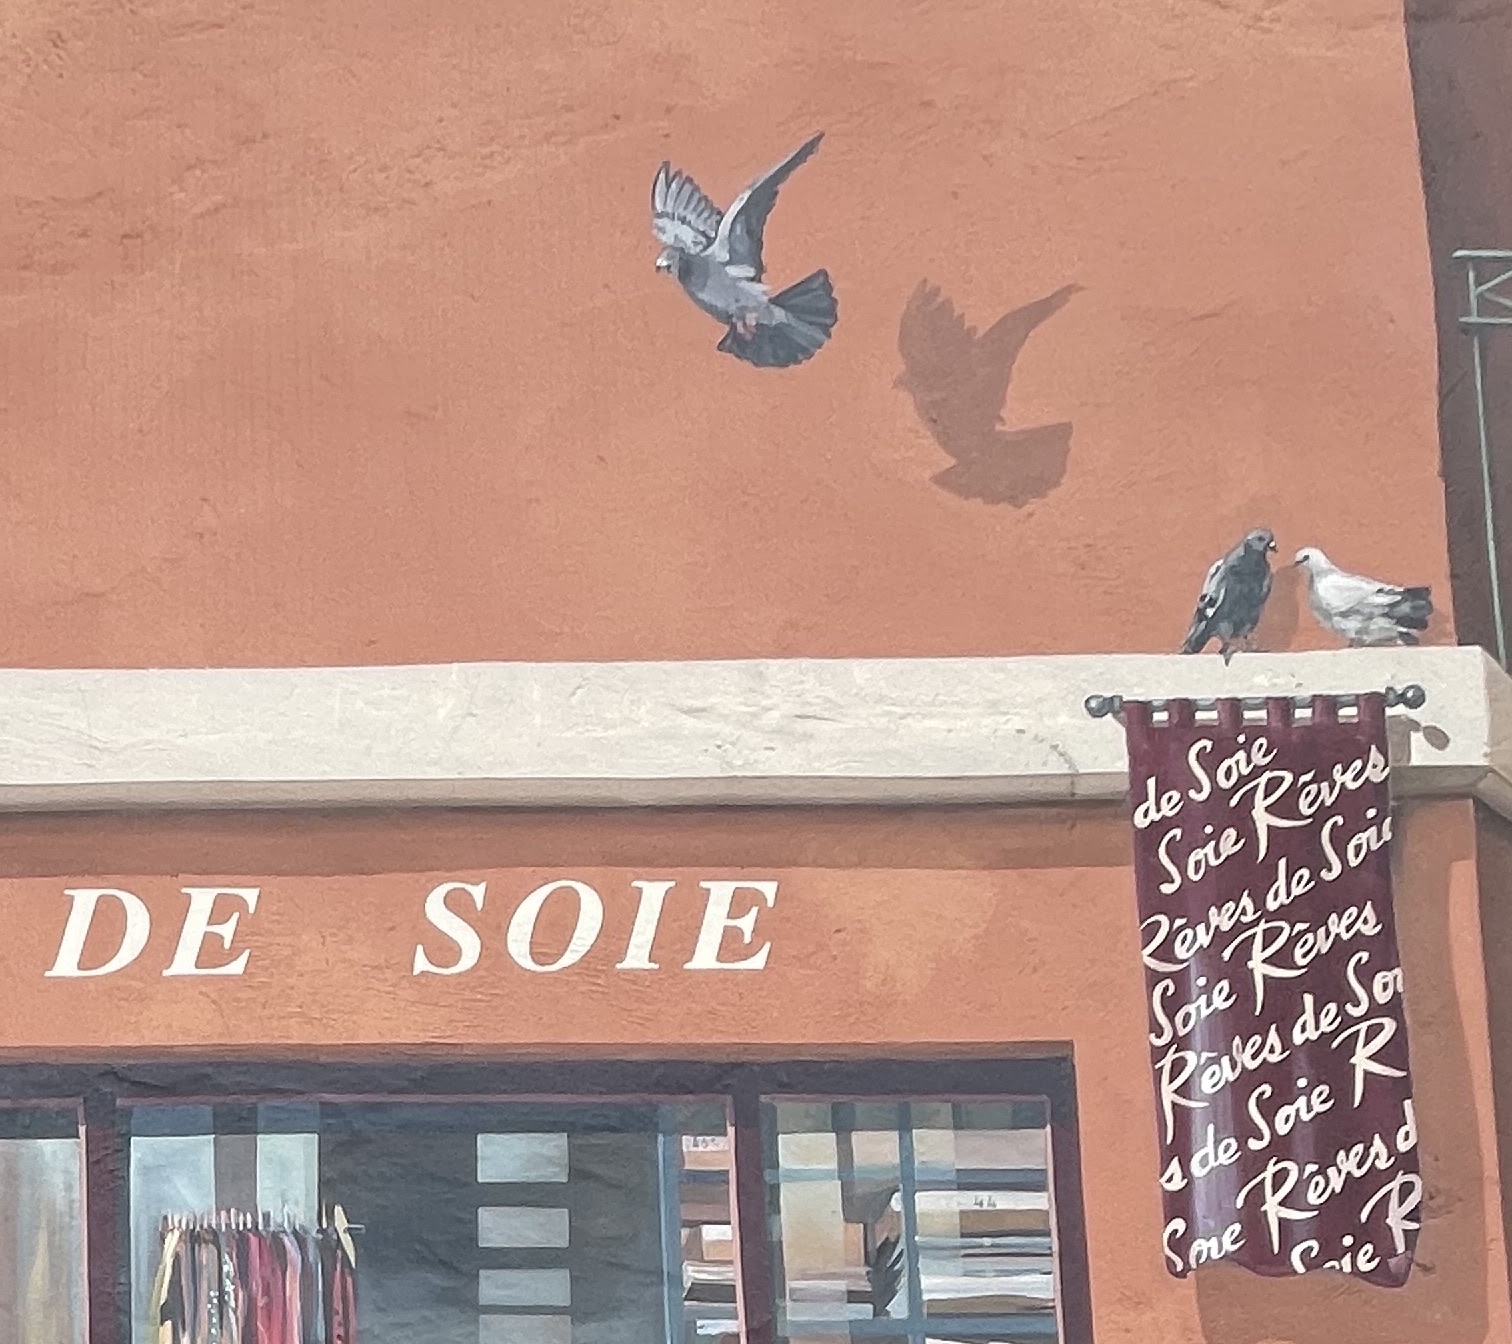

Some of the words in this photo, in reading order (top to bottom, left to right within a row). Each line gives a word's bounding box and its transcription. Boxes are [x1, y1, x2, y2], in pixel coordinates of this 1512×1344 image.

[1134, 776, 1185, 829] de
[1188, 733, 1278, 801] Soie
[1158, 824, 1245, 894] Soie
[1266, 857, 1316, 912] de
[44, 886, 261, 977] DE
[413, 879, 778, 976] SOIE
[1149, 976, 1237, 1046] Soie
[1293, 993, 1342, 1046] de
[1190, 1123, 1241, 1179] de
[1247, 1077, 1335, 1151] Soie
[1331, 1017, 1408, 1109] R
[1162, 1217, 1246, 1272] Soie
